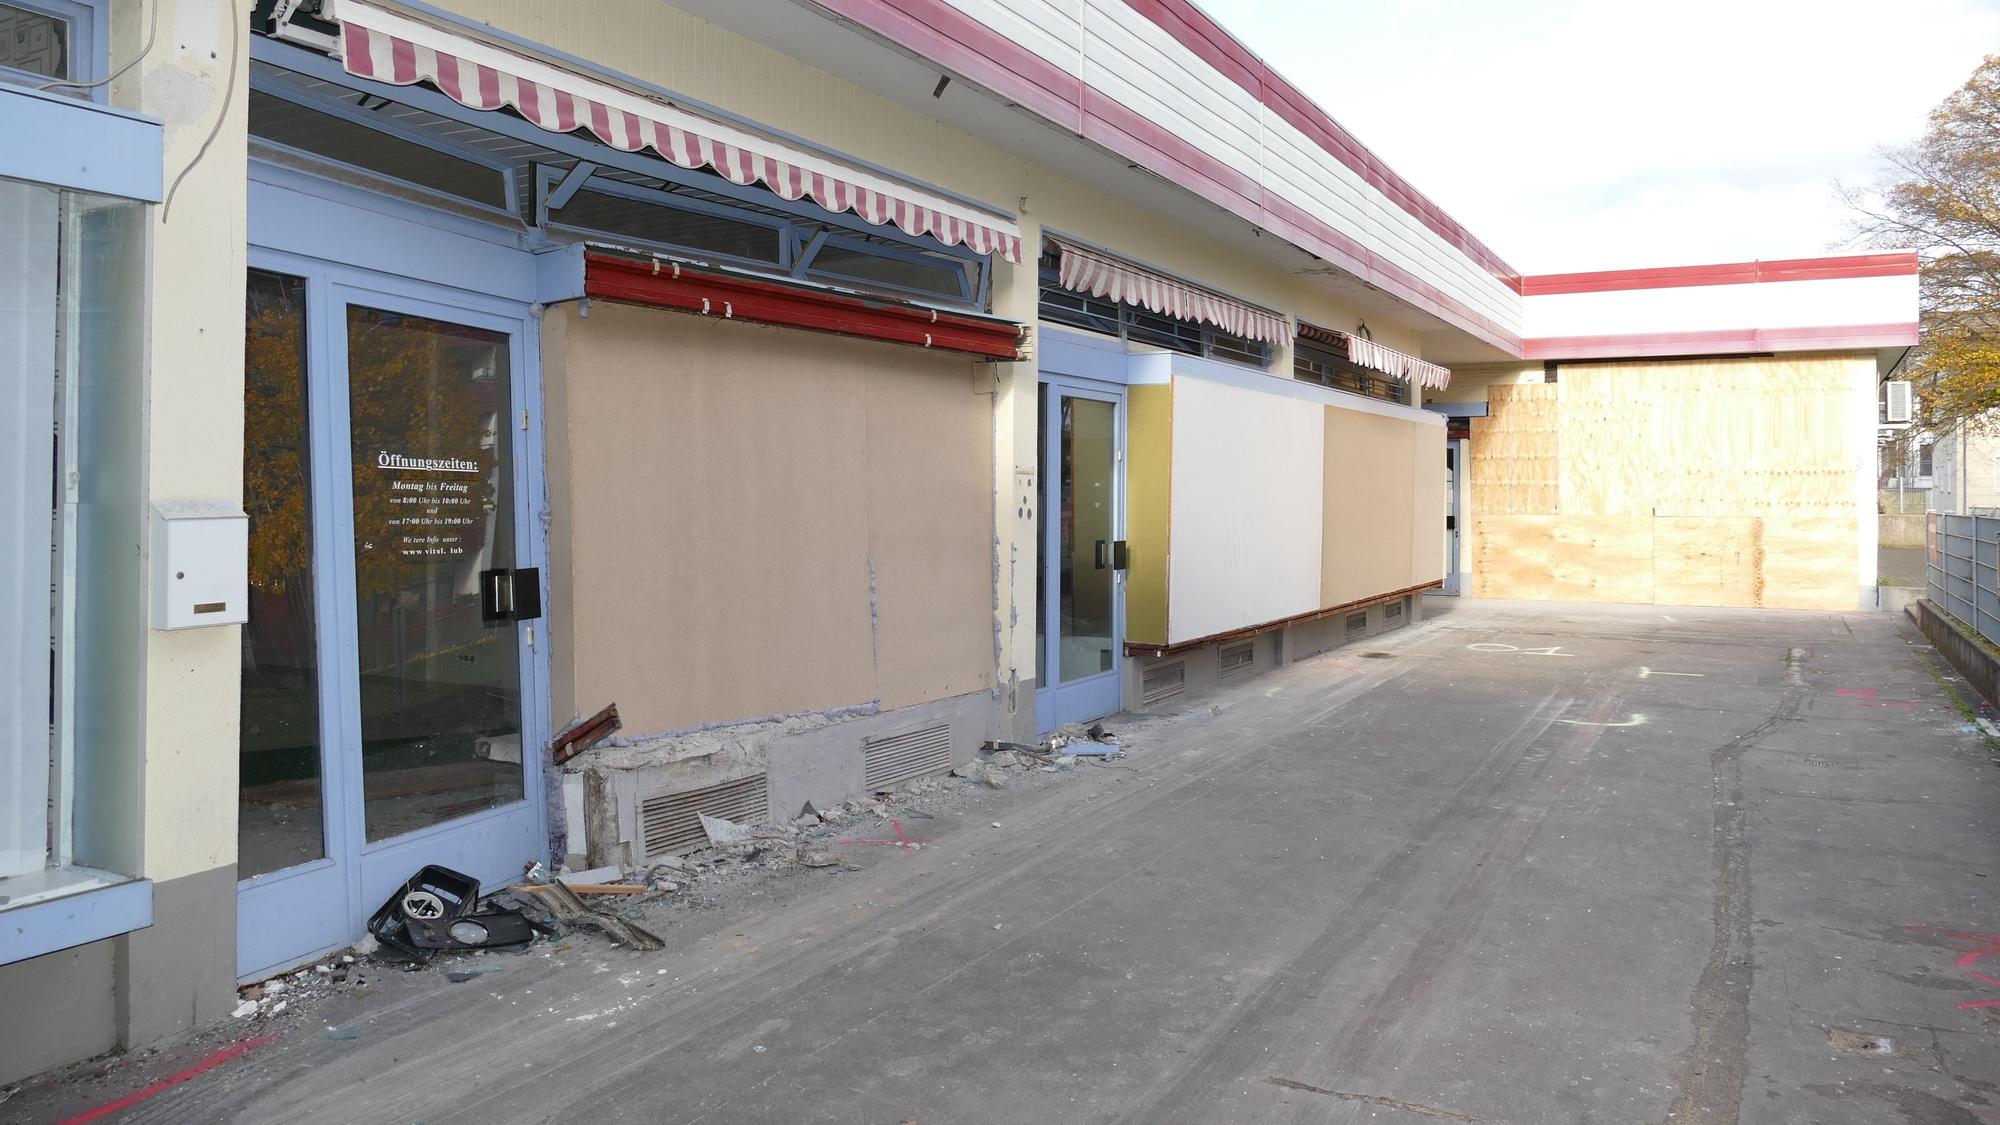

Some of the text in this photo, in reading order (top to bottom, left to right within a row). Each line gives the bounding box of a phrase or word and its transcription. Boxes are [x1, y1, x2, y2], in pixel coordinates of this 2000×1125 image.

[378, 450, 478, 472] Öffnungszeiten:
[391, 481, 468, 493] Montag bis Freitag
[427, 536, 439, 544] Info
